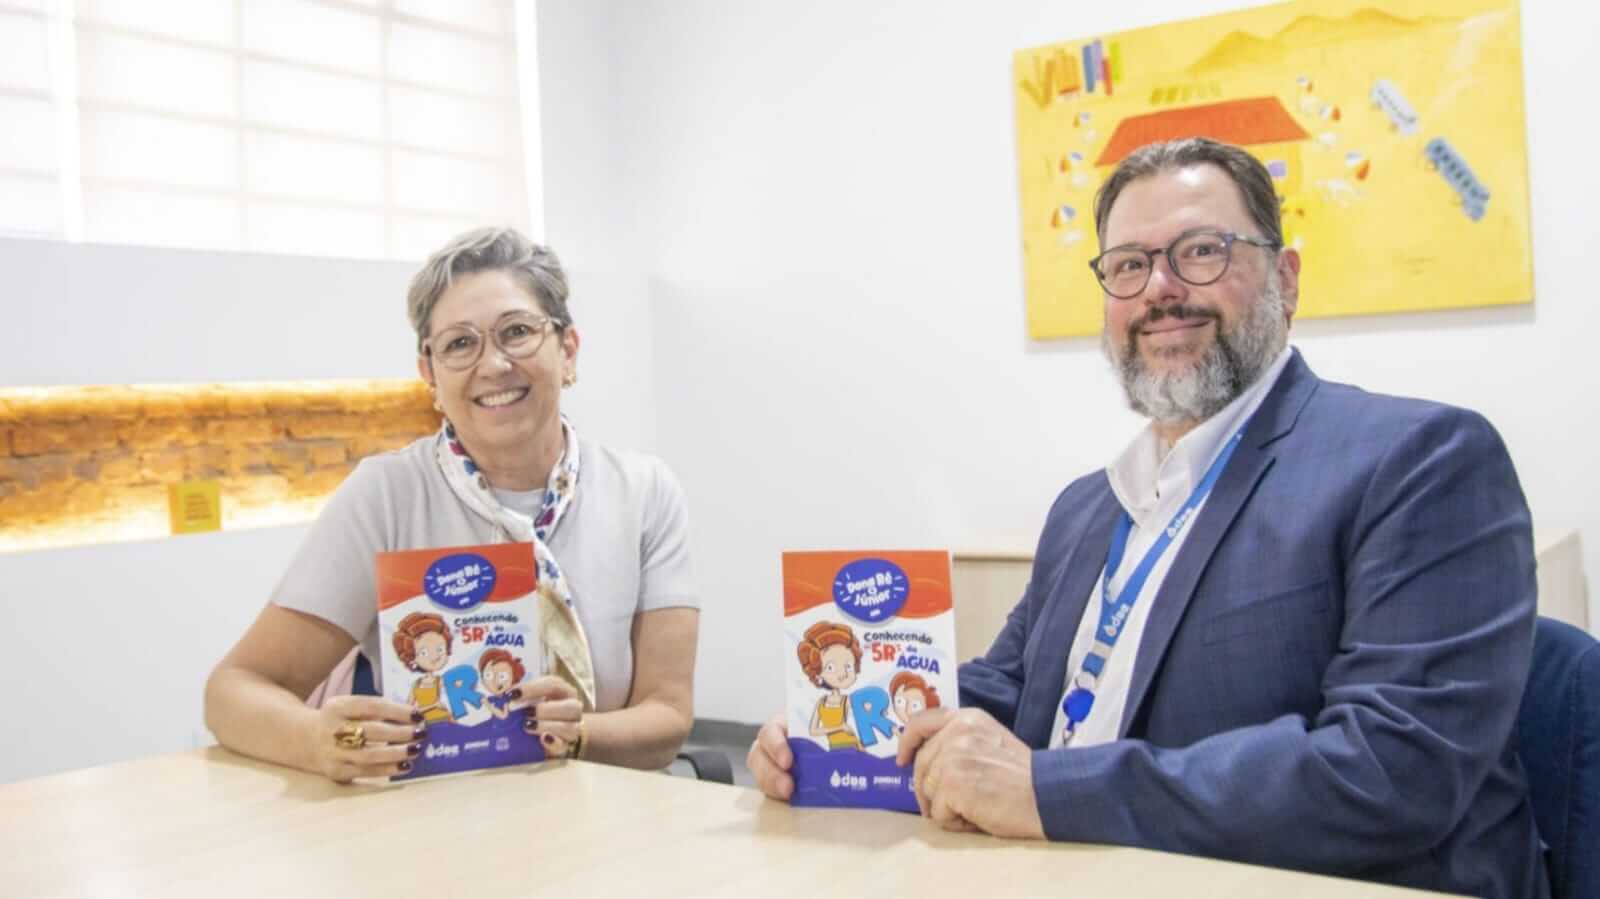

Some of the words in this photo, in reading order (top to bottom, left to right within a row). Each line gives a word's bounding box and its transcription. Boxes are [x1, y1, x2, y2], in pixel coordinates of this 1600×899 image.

[846, 576, 876, 594] Dona
[853, 589, 890, 606] Júnior
[454, 612, 518, 627] Conhecendo
[863, 631, 933, 645] Conhecendo
[442, 664, 483, 720] R
[850, 686, 897, 748] R
